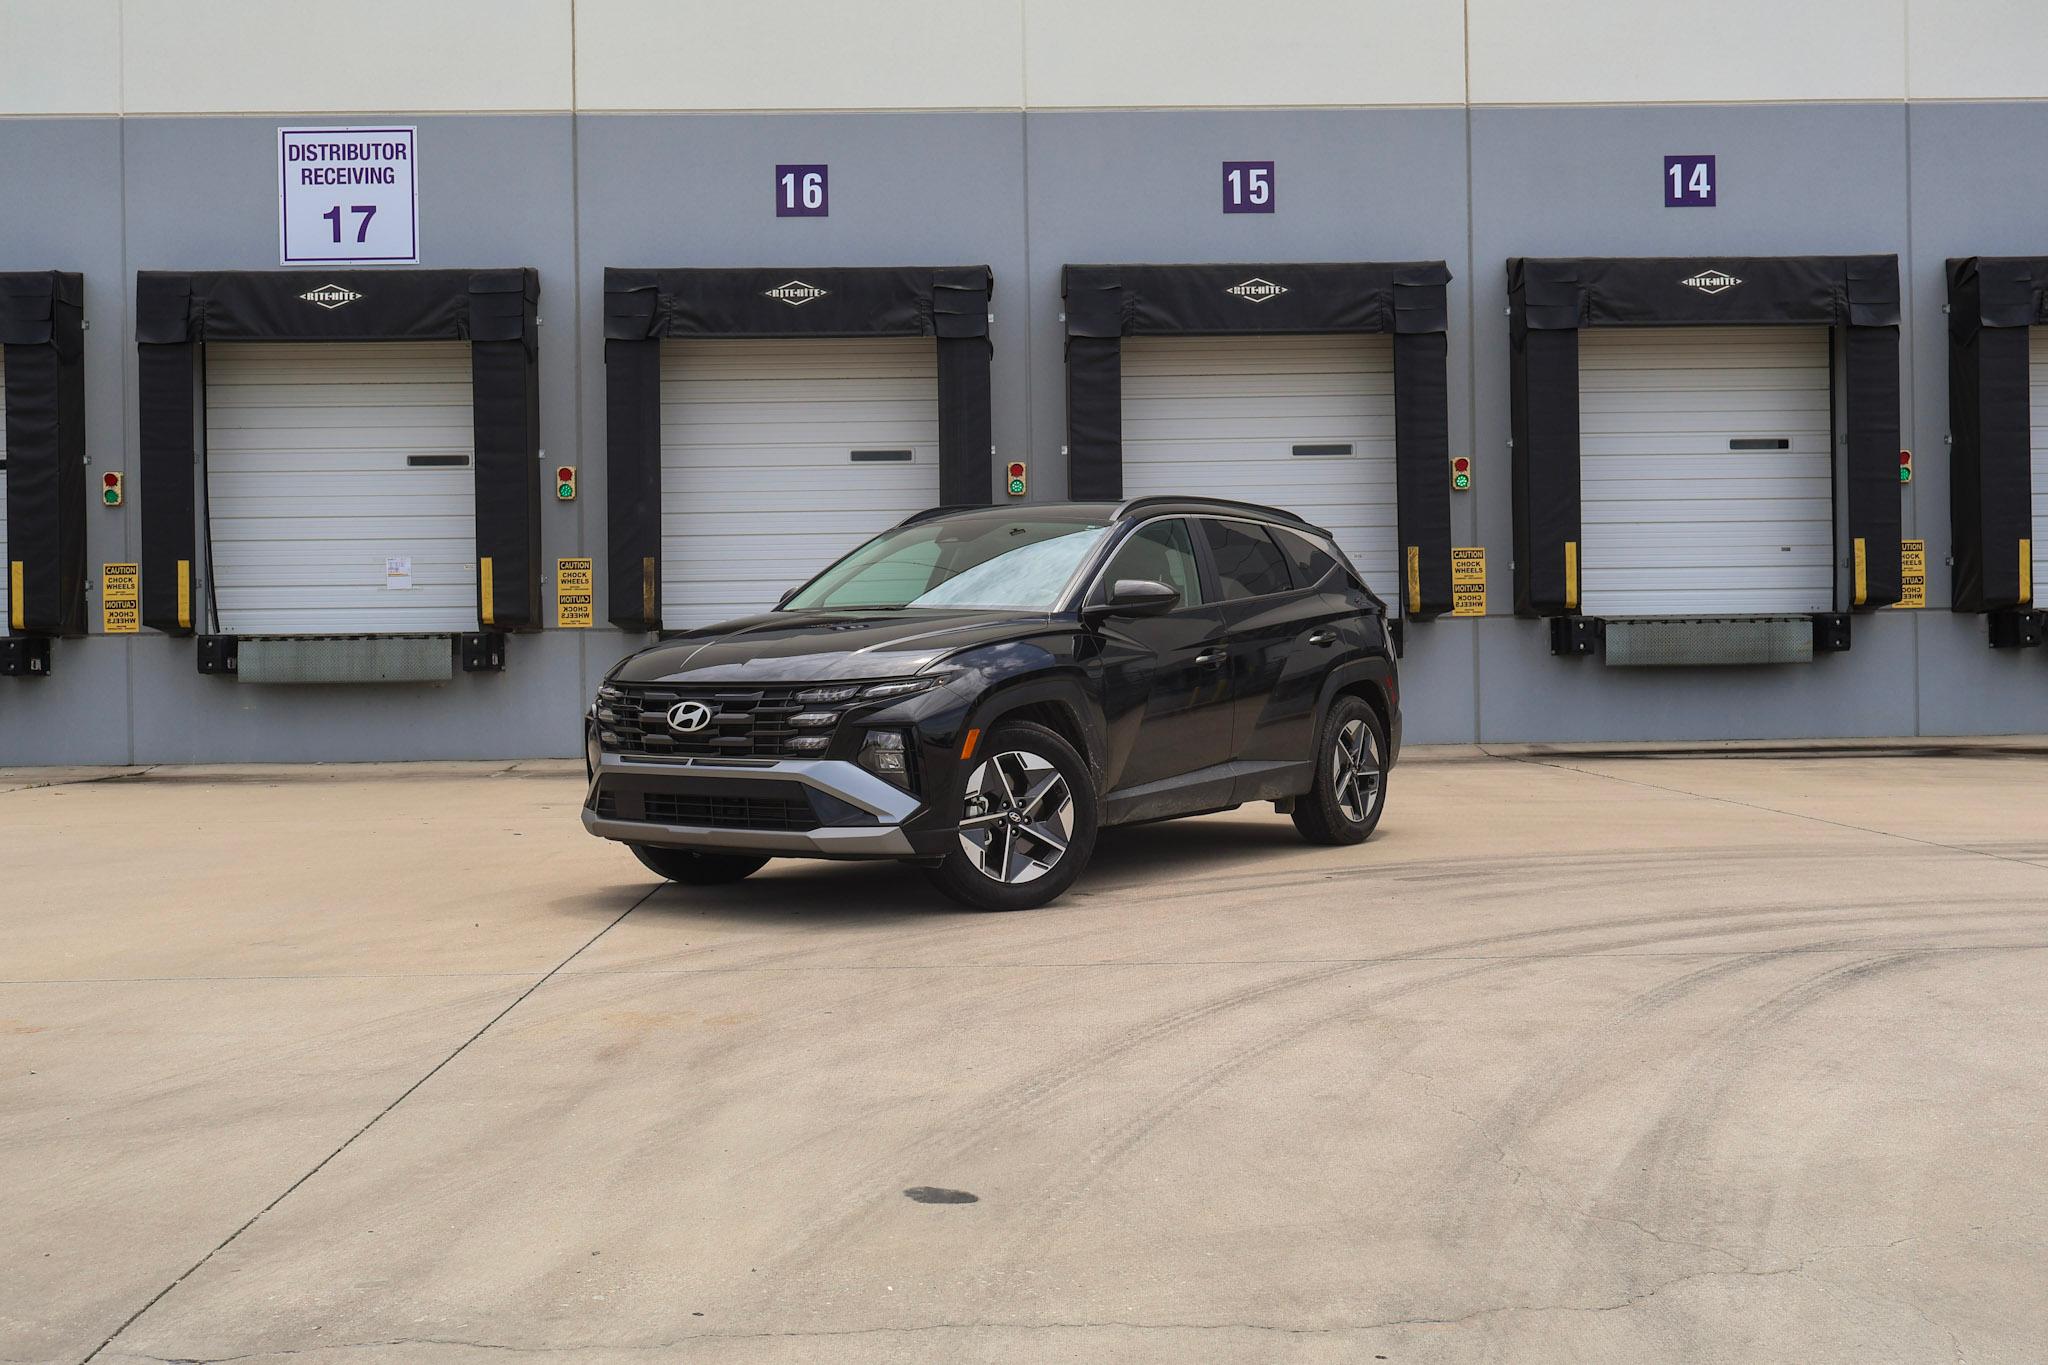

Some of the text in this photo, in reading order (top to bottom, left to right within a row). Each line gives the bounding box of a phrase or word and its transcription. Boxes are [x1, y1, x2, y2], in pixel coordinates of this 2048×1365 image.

[288, 143, 407, 161] DISTRIBUTOR
[301, 167, 395, 185] RECEIVING
[1669, 163, 1711, 199] 14
[781, 172, 823, 209] 16
[1228, 169, 1269, 205] 15
[323, 205, 377, 243] 17
[1454, 551, 1482, 559] CAUTION
[1902, 543, 1922, 551] UTION
[106, 566, 136, 574] CAUTION
[560, 561, 589, 569] CAUTION
